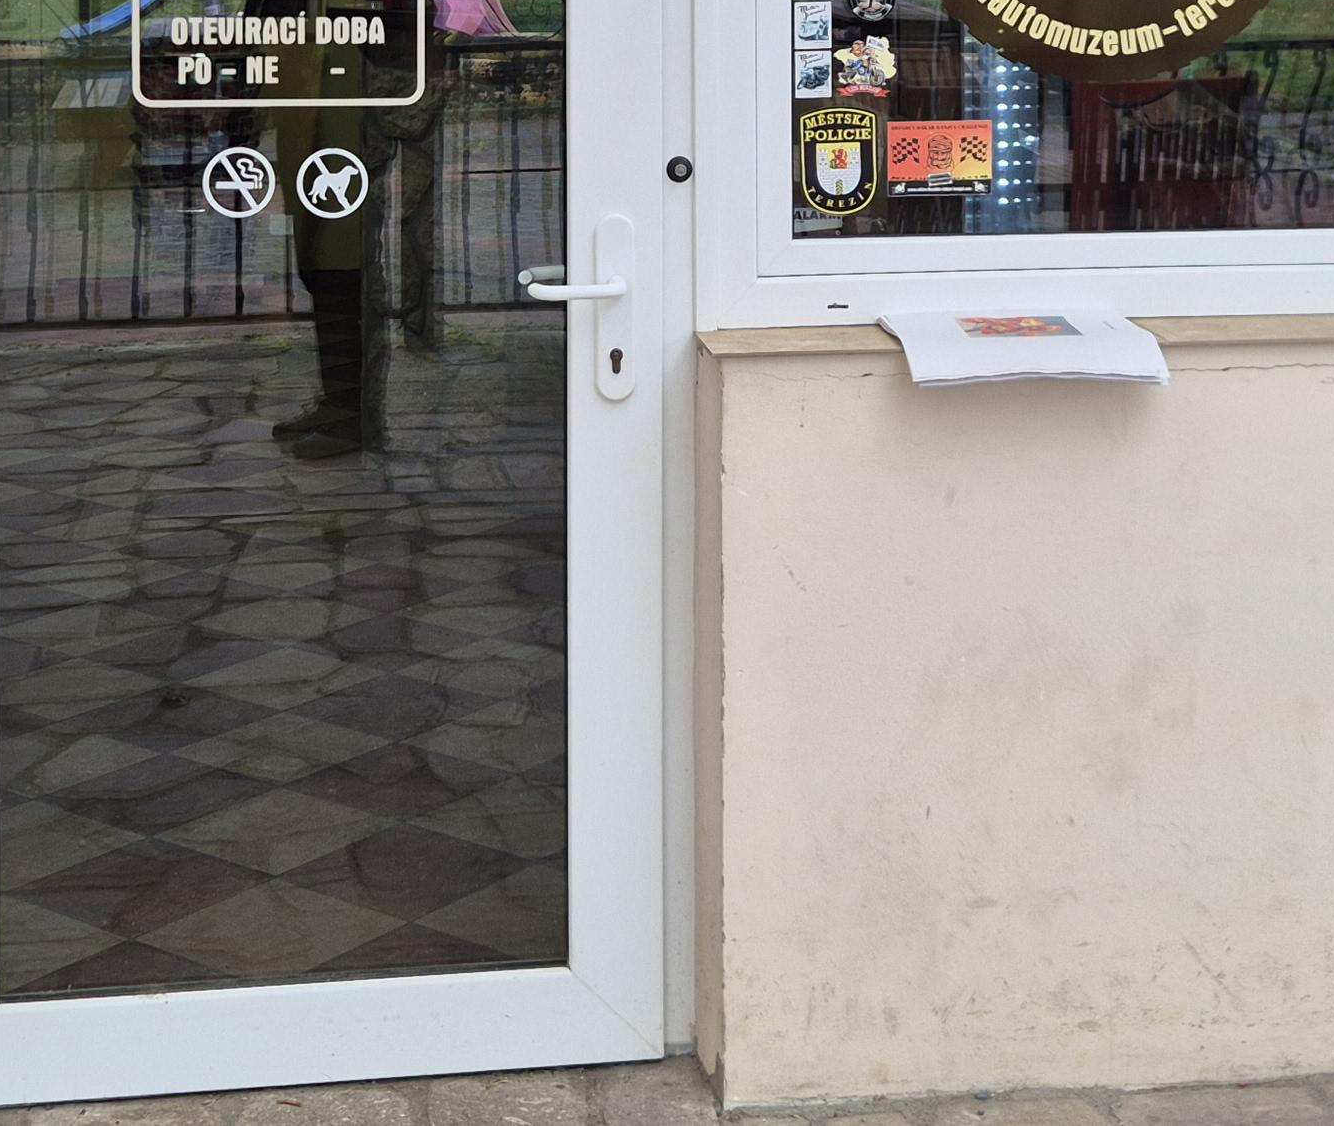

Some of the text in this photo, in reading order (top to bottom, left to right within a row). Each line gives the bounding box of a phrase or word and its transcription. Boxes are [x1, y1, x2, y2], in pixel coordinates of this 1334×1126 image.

[171, 10, 386, 46] OTEVÍRACÍ DOBA
[177, 55, 212, 86] PO
[245, 55, 279, 86] NE
[804, 112, 871, 129] MĚSTSKÁ
[804, 128, 872, 142] POLICIE
[794, 210, 841, 220] ALAR
